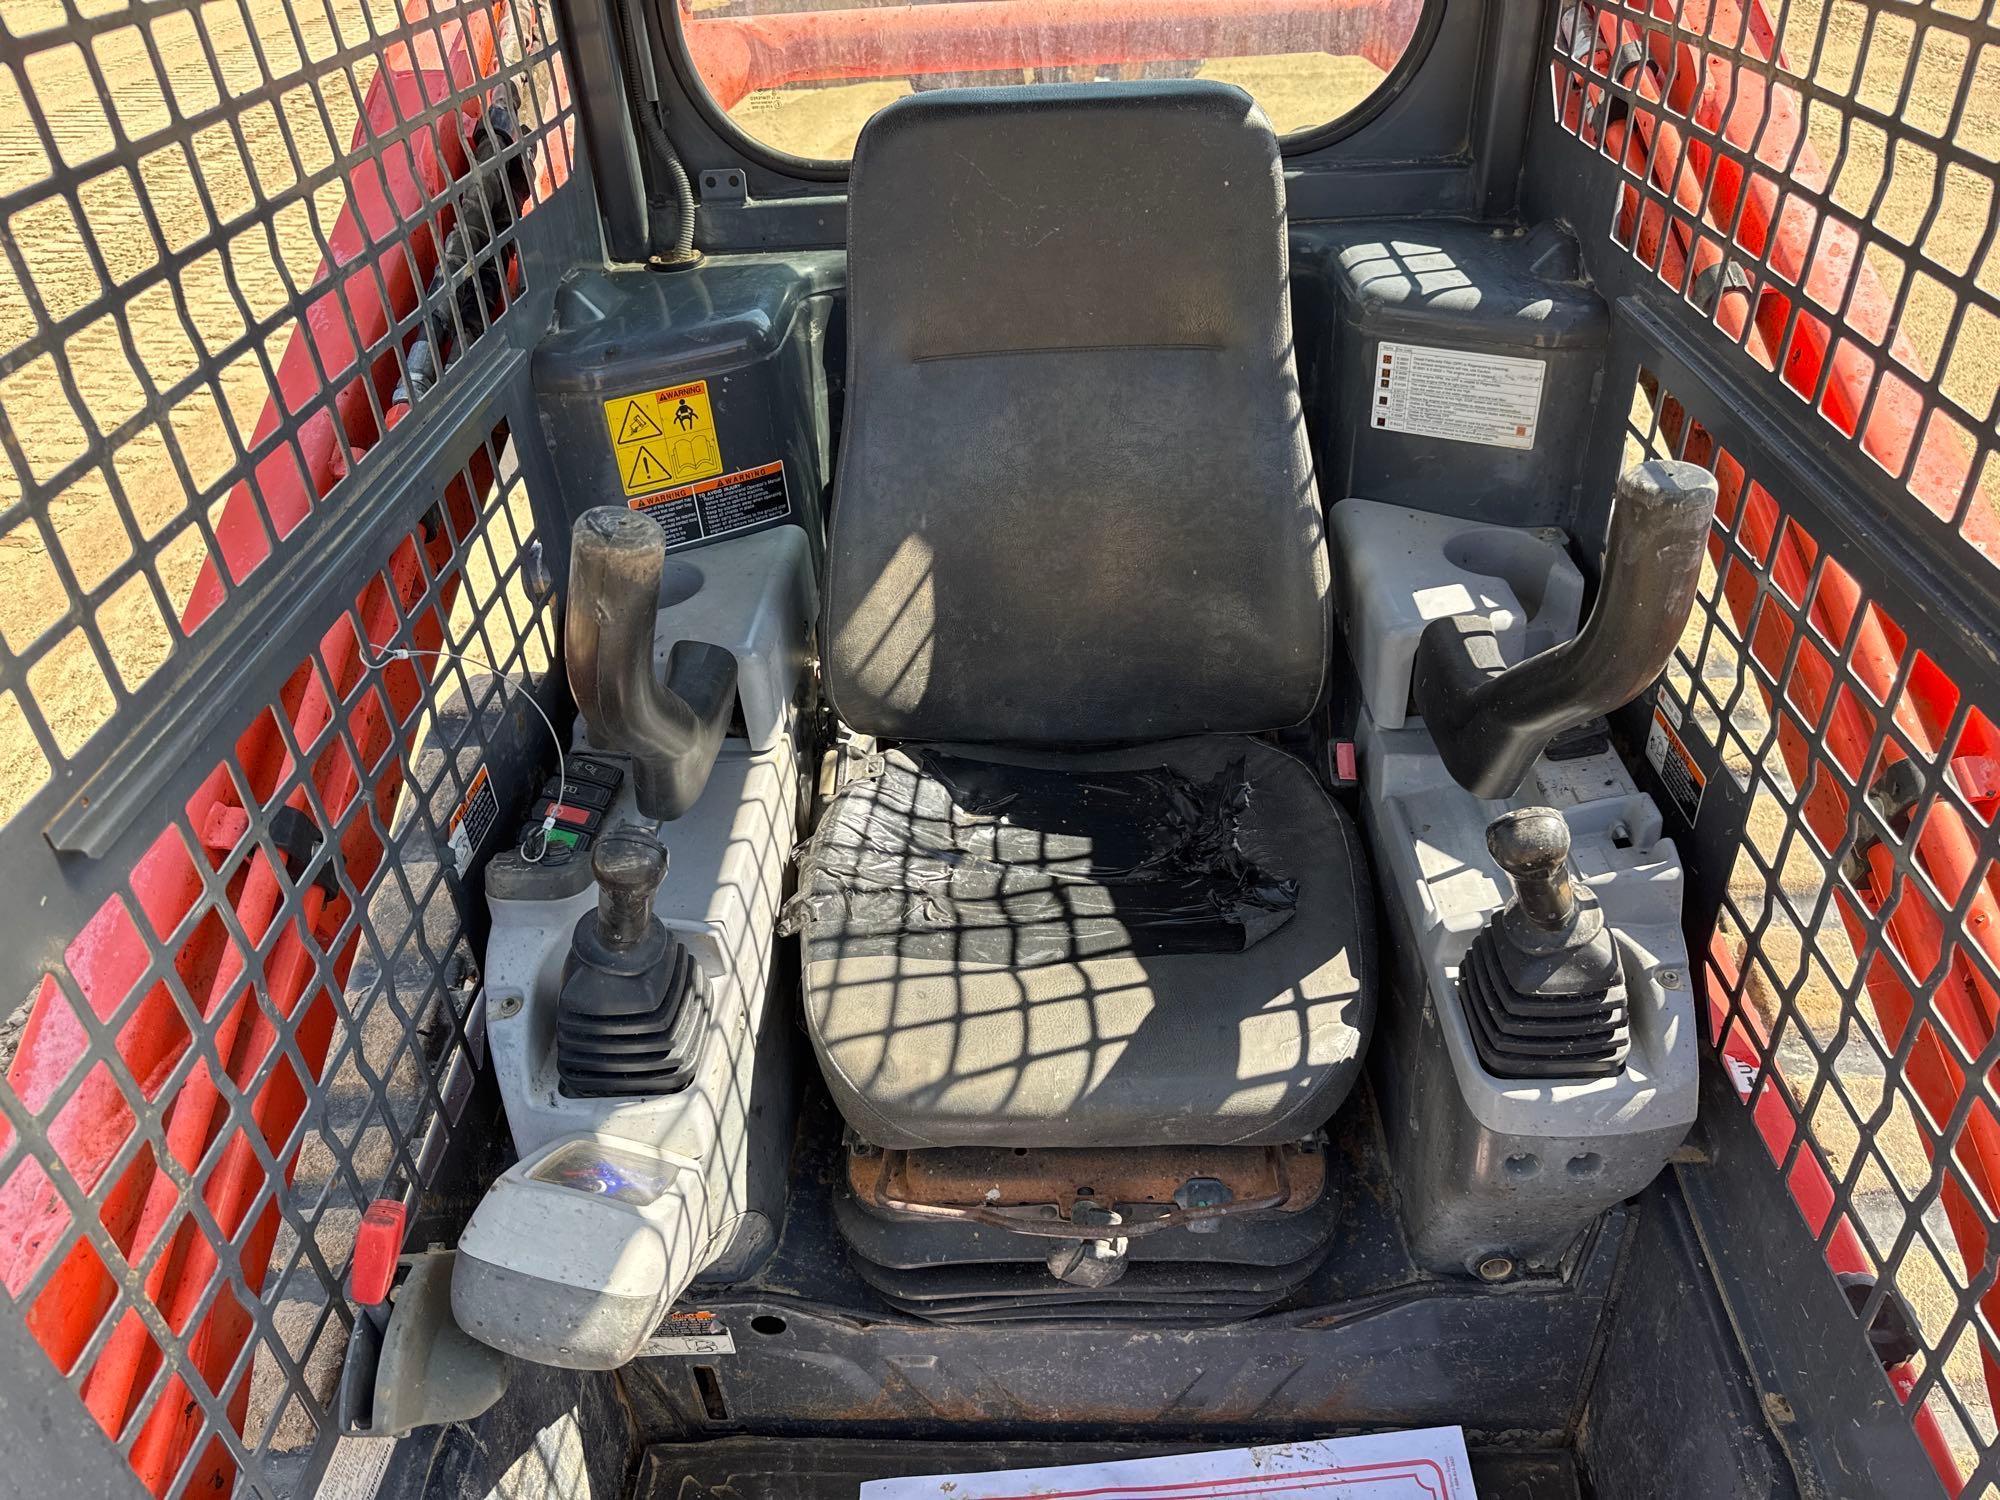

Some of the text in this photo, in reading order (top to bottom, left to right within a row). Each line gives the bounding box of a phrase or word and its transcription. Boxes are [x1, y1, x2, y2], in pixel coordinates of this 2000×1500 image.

[666, 386, 702, 399] WARNING
[726, 468, 765, 484] WARNING
[647, 490, 686, 503] WARNING
